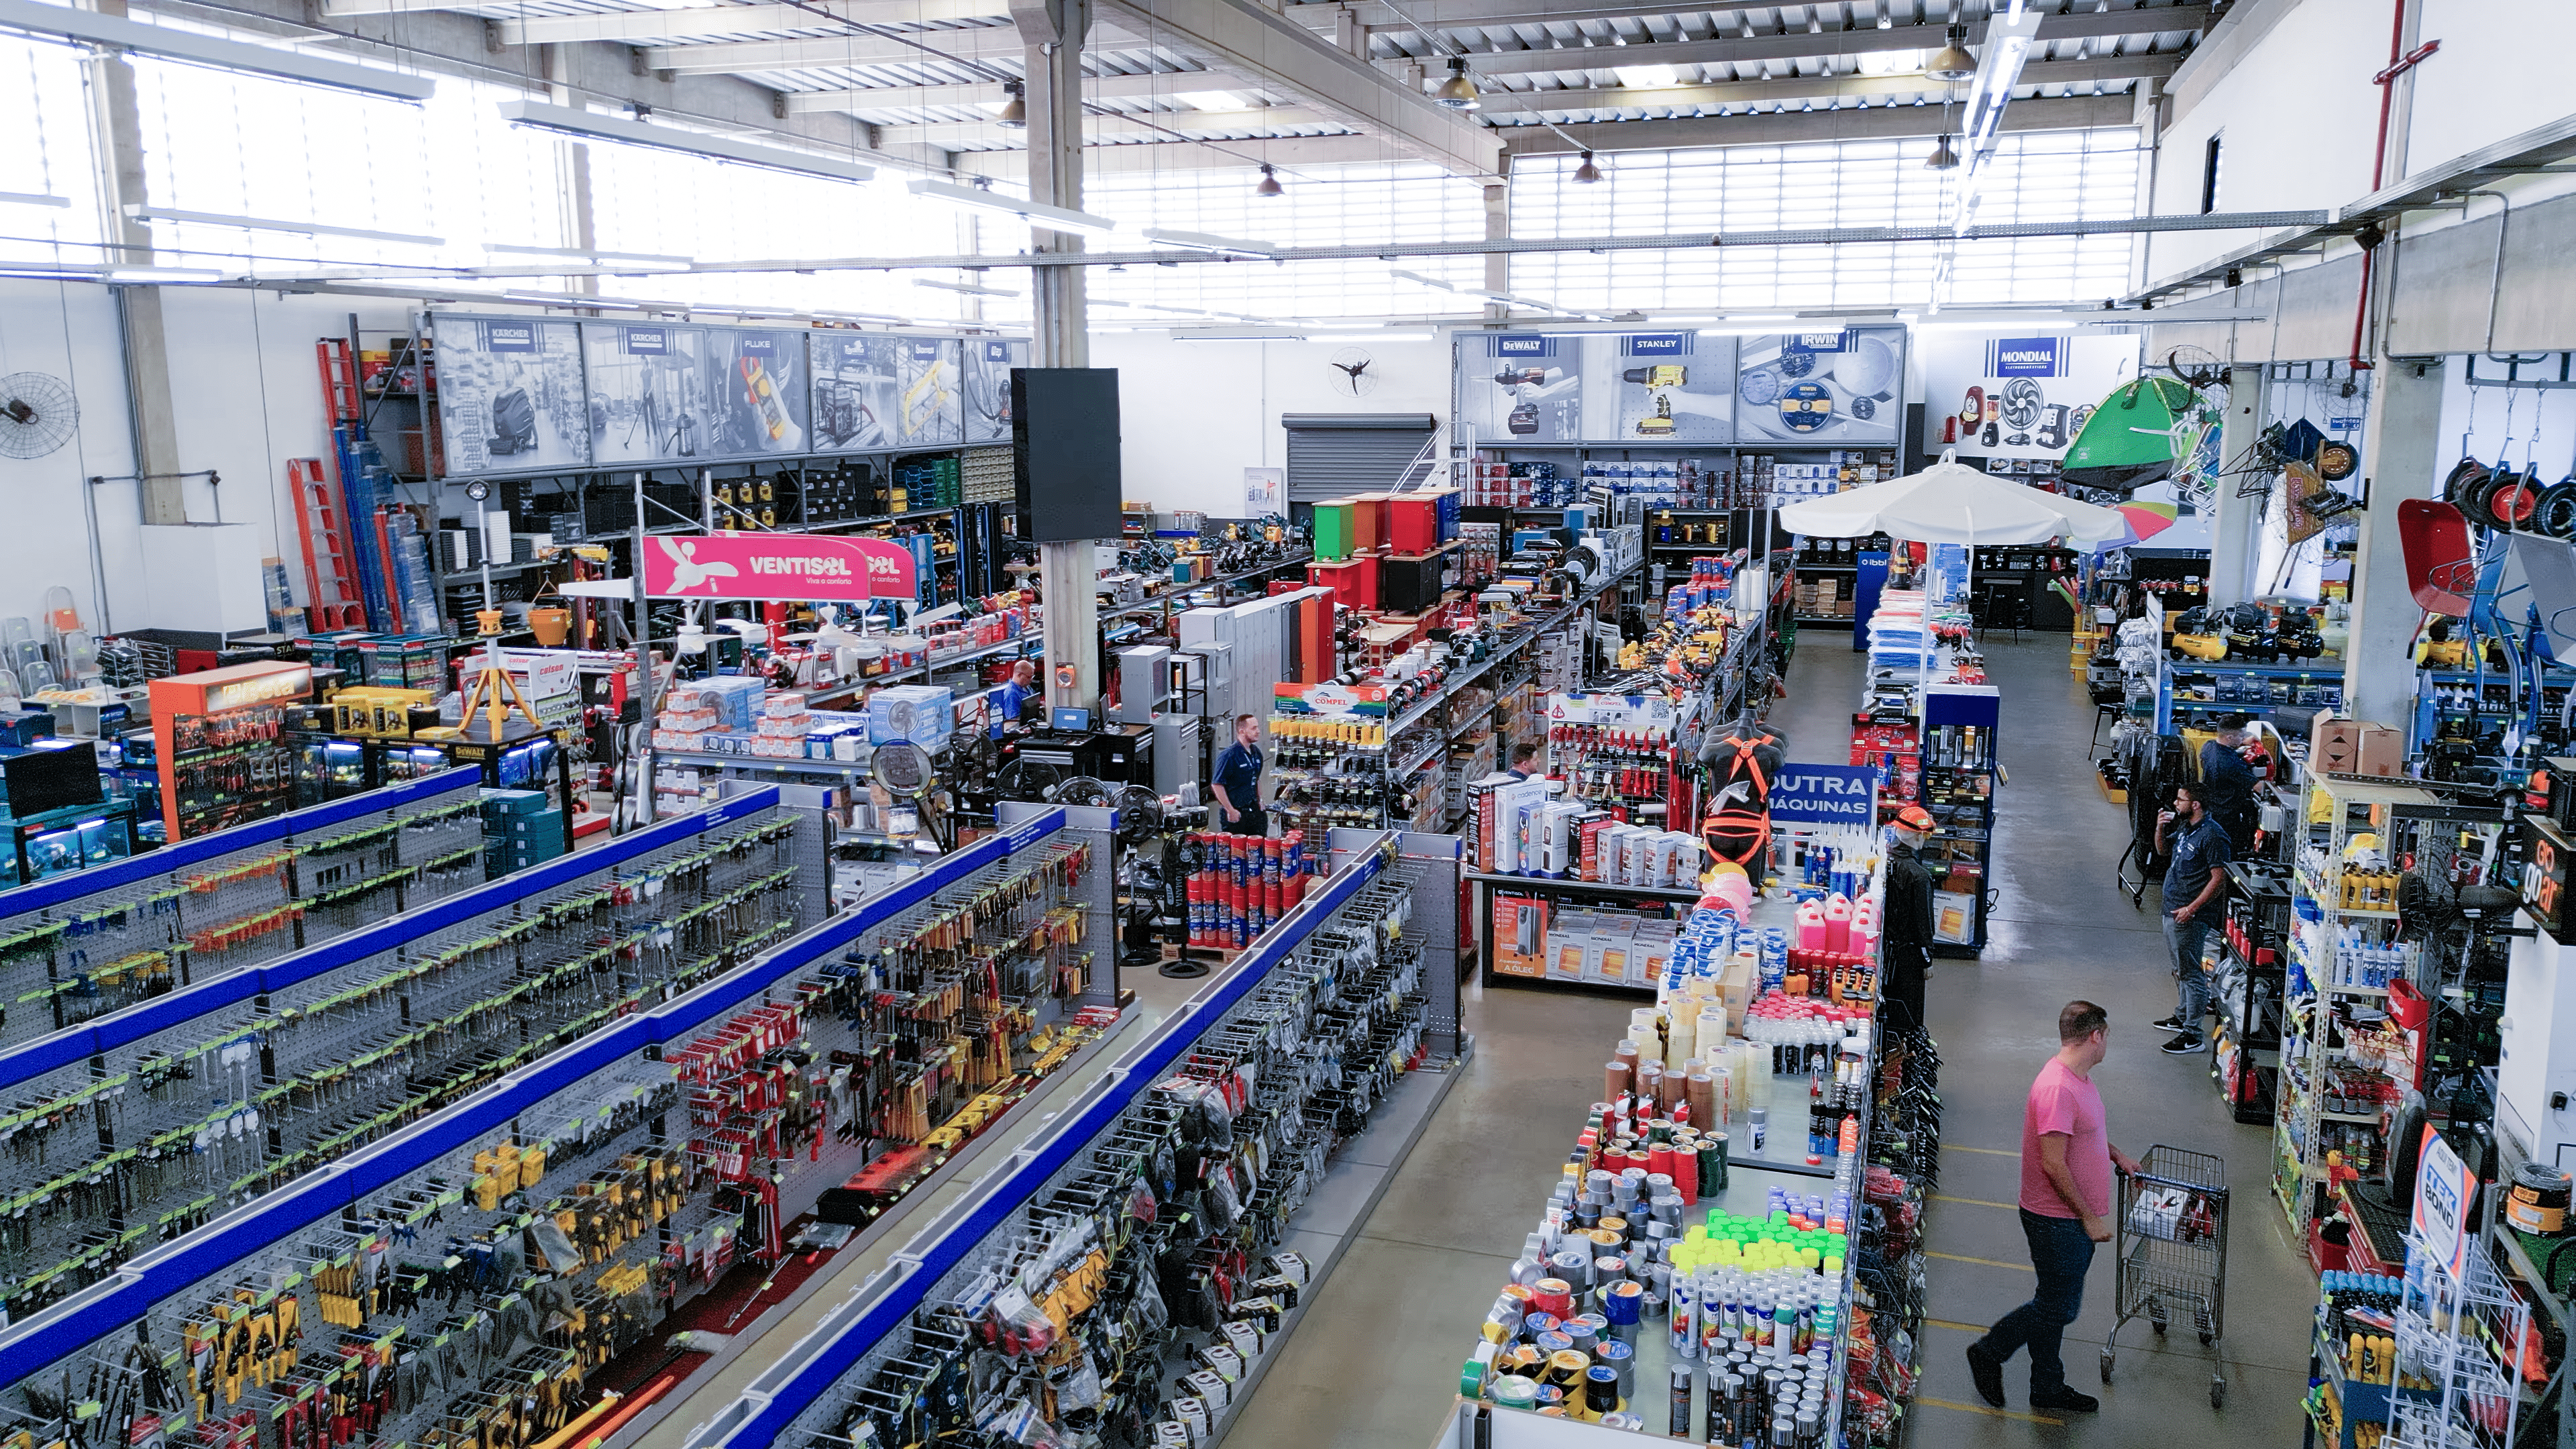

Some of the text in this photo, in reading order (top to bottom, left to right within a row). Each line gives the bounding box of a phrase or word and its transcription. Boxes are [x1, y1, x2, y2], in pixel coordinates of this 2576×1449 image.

[745, 340, 771, 348] FLUKE
[1801, 334, 1838, 344] IRWIN
[2001, 351, 2053, 362] MONDIAL
[749, 557, 852, 575] VENTISOL
[1315, 698, 1348, 706] COMPEL
[1517, 790, 1542, 799] cadence
[2425, 1183, 2454, 1230] BOND
